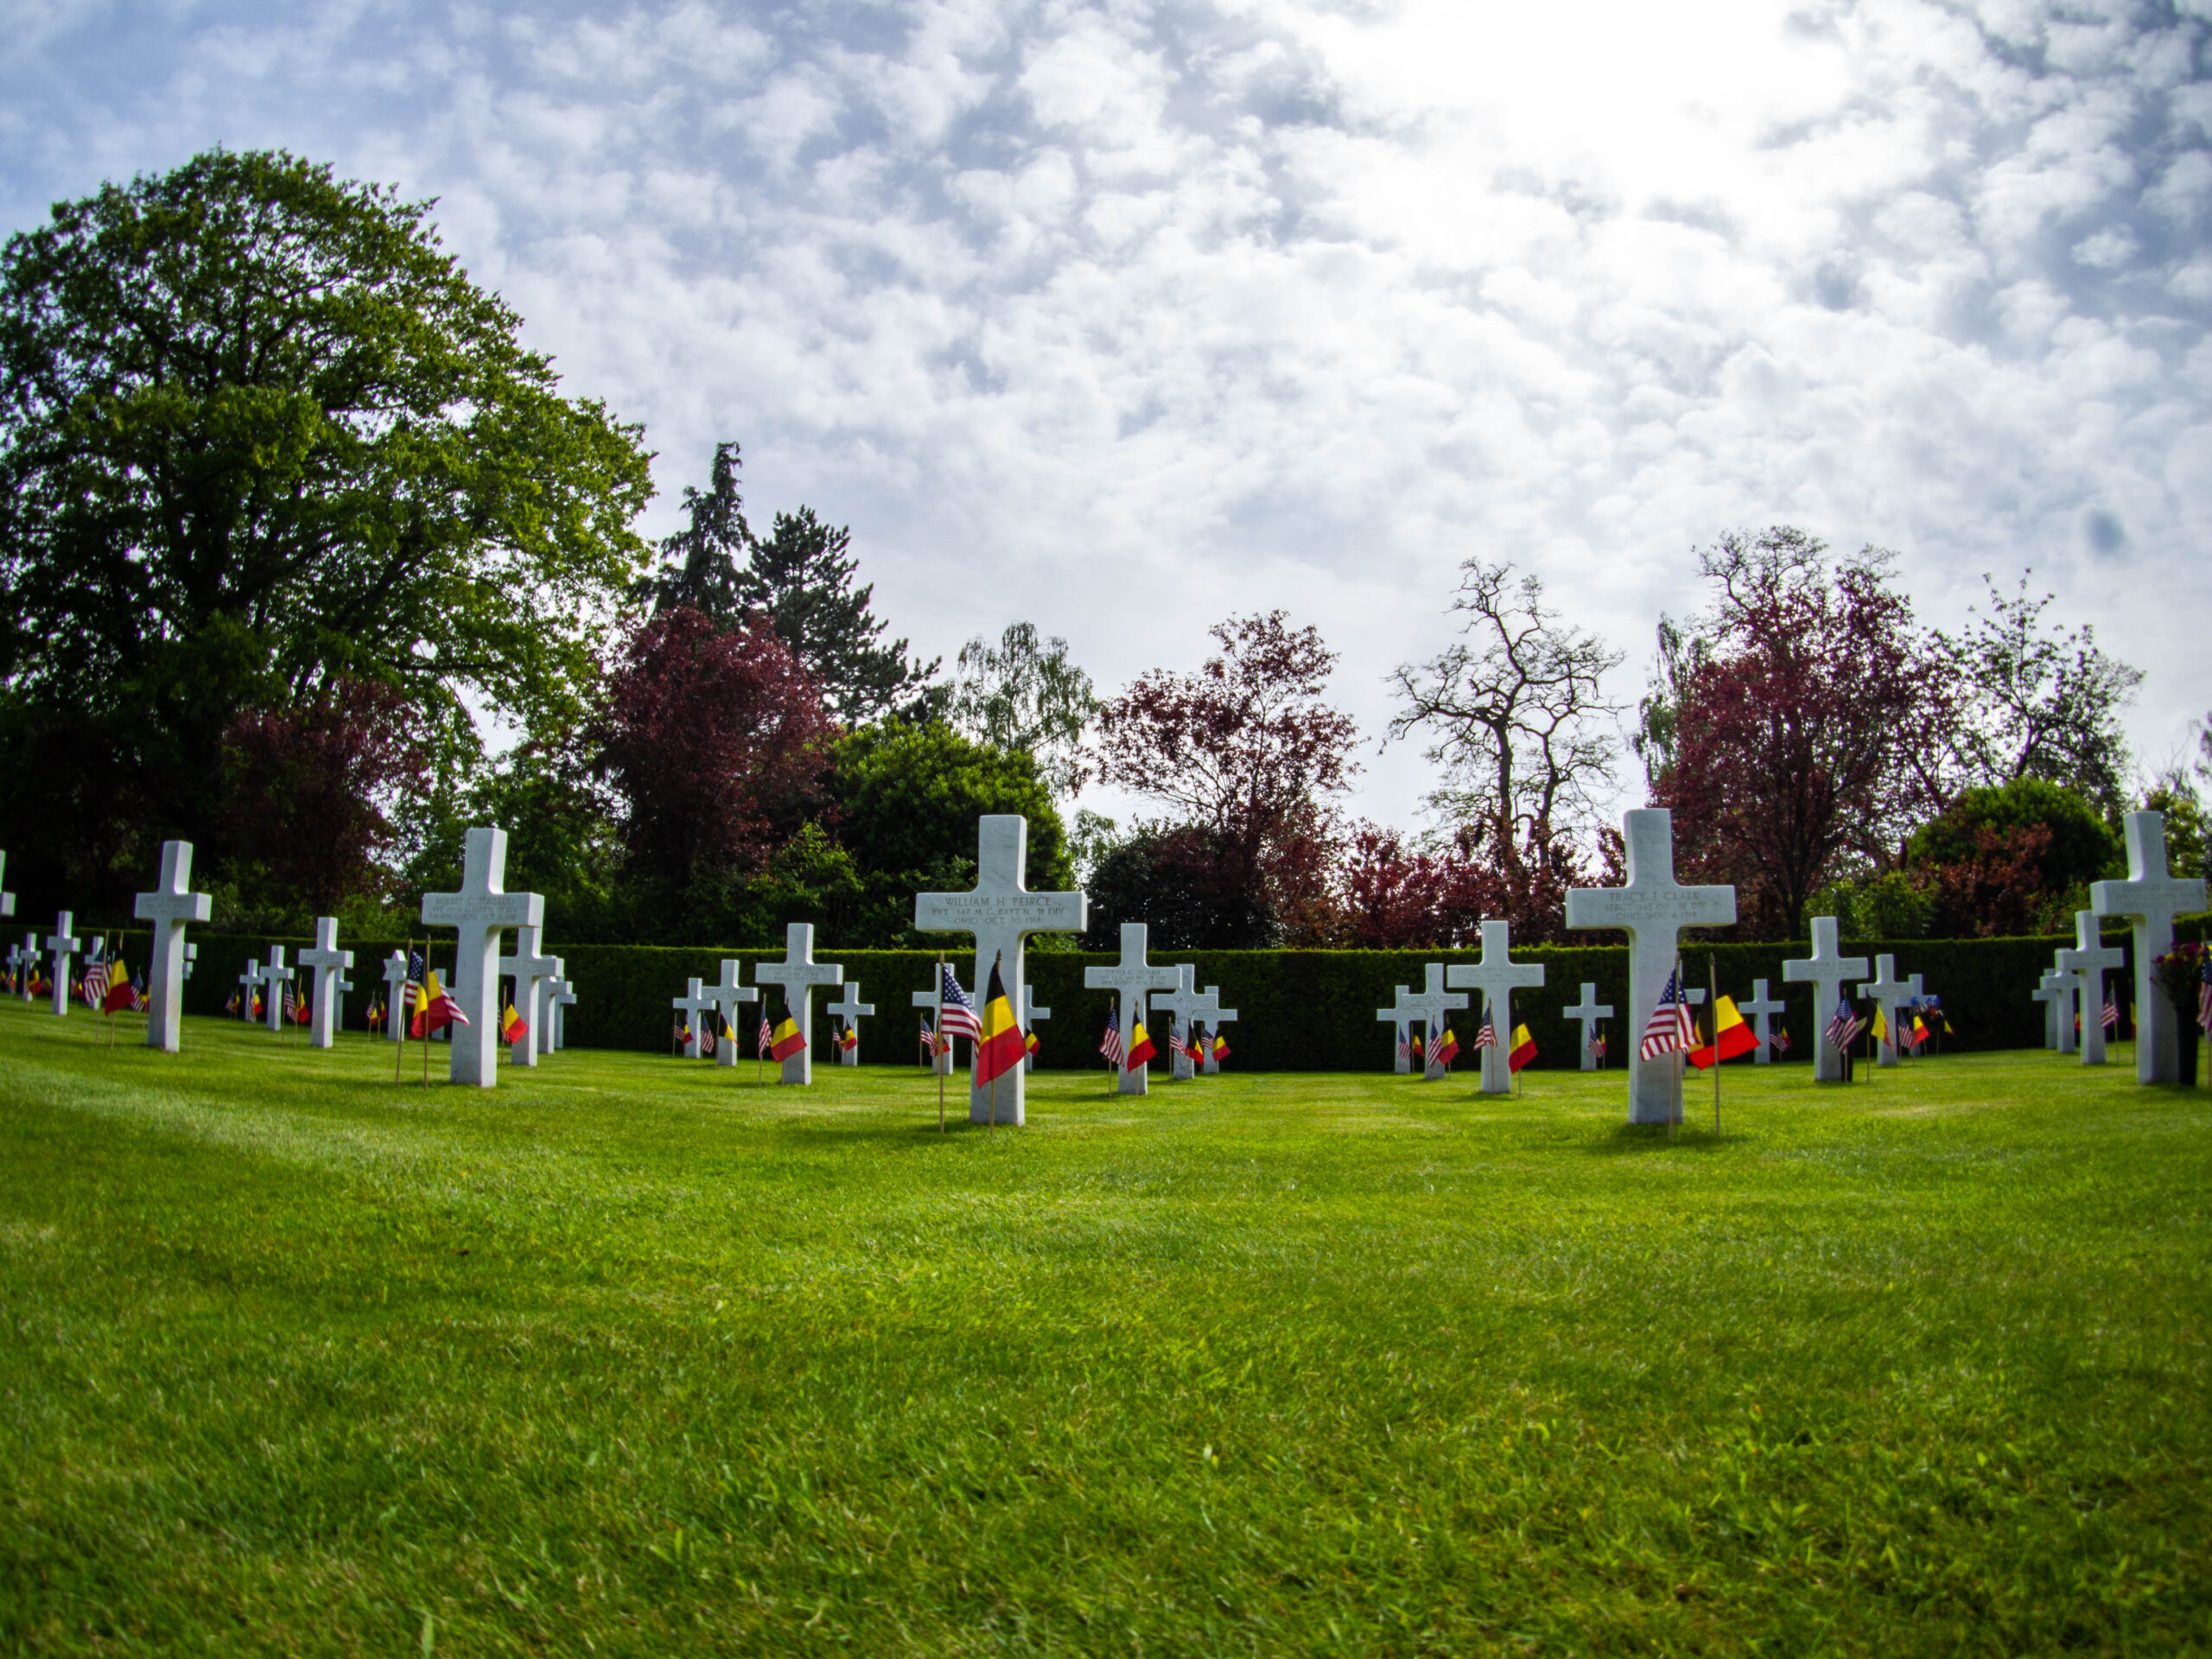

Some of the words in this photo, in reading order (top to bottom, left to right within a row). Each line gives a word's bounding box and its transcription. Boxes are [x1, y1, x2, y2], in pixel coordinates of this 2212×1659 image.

[1609, 892, 1647, 901] TRACY
[1664, 891, 1700, 900] CLARK
[945, 897, 989, 906] WILLIAM
[996, 897, 1005, 906] H
[1013, 897, 1051, 906] PEIRCE
